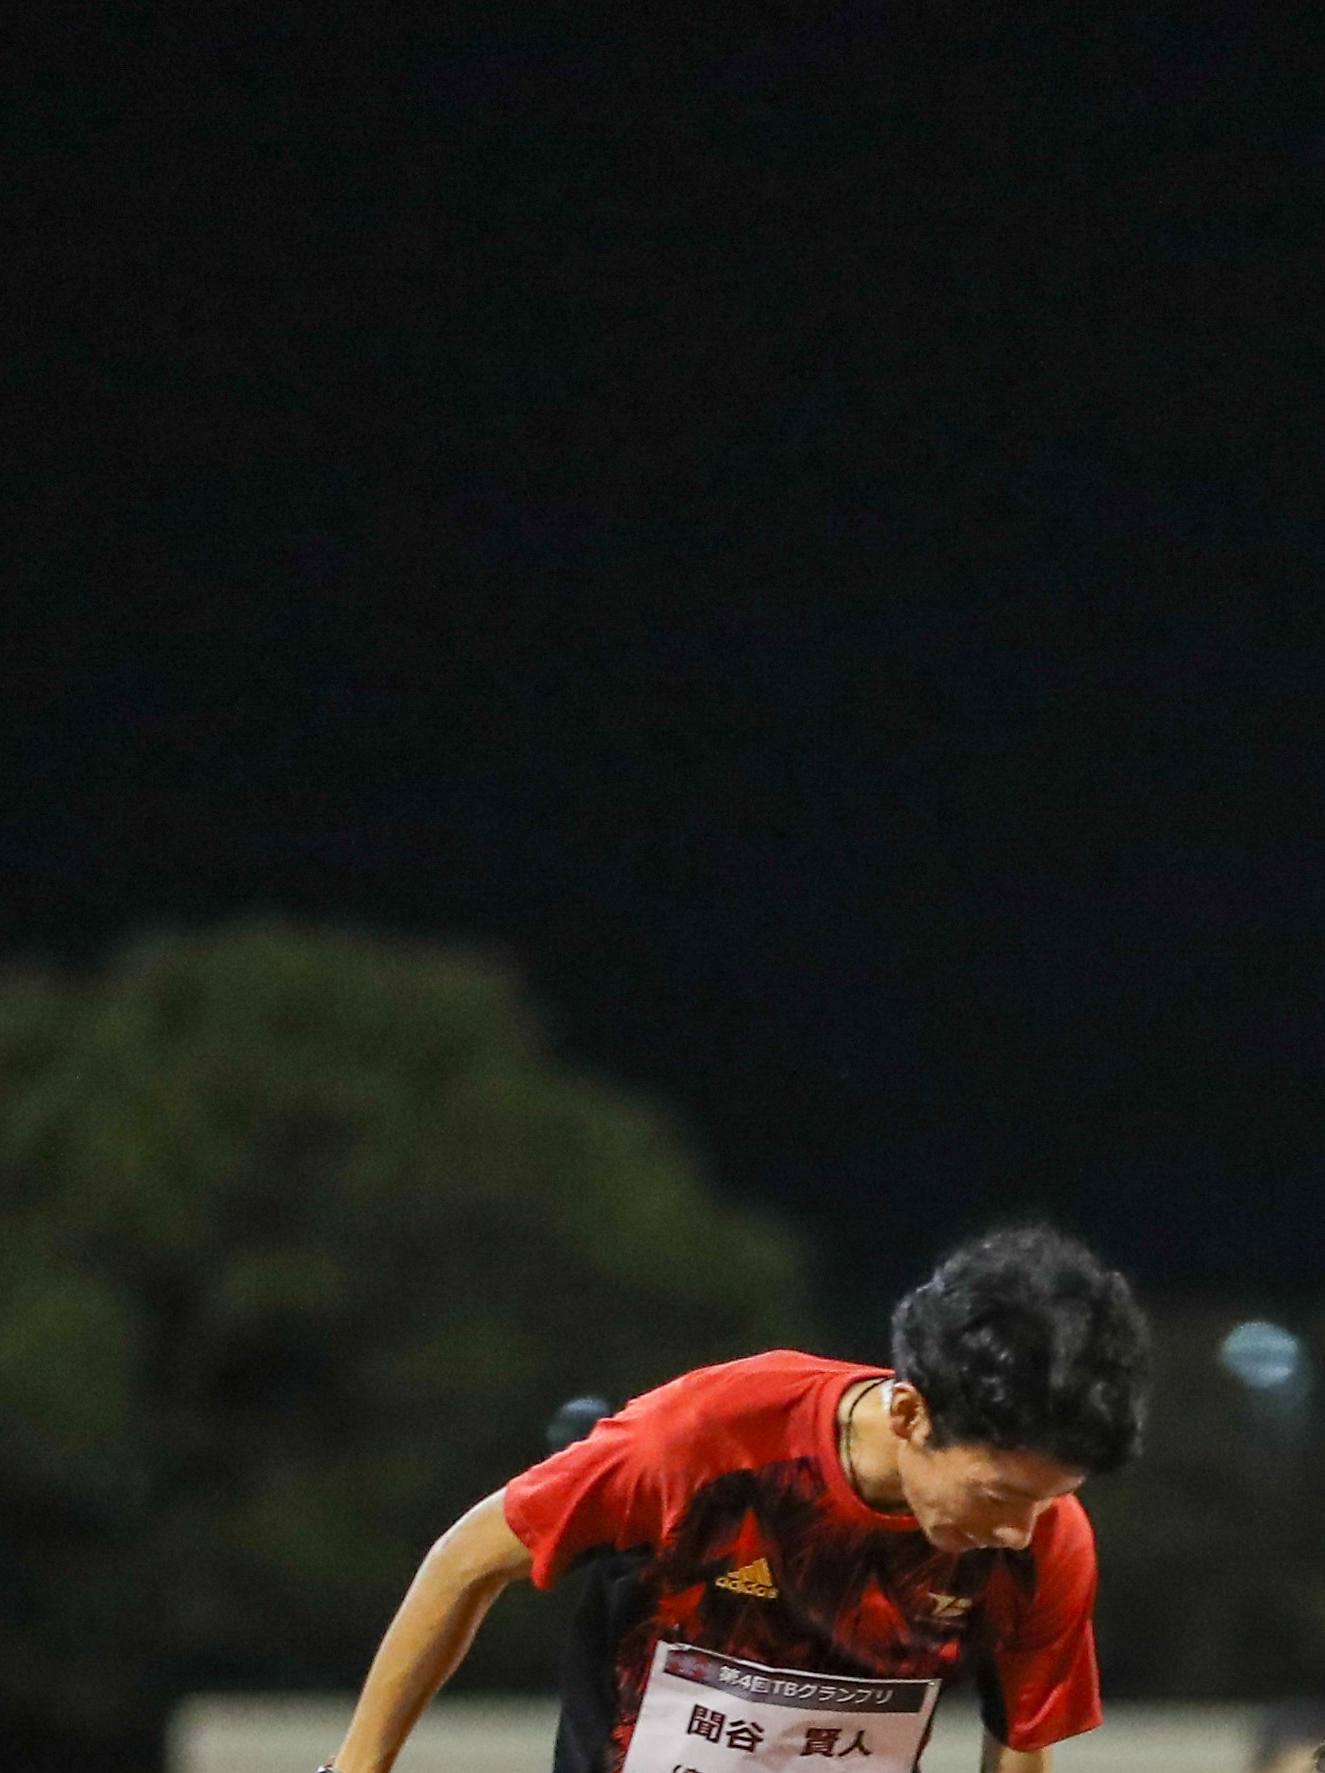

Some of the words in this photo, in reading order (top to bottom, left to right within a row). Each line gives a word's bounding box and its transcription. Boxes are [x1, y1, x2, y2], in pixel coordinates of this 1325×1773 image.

[718, 1665, 894, 1705] 第4回TBグランプリ
[687, 1704, 764, 1753] 聞谷
[800, 1728, 874, 1757] 賢人
